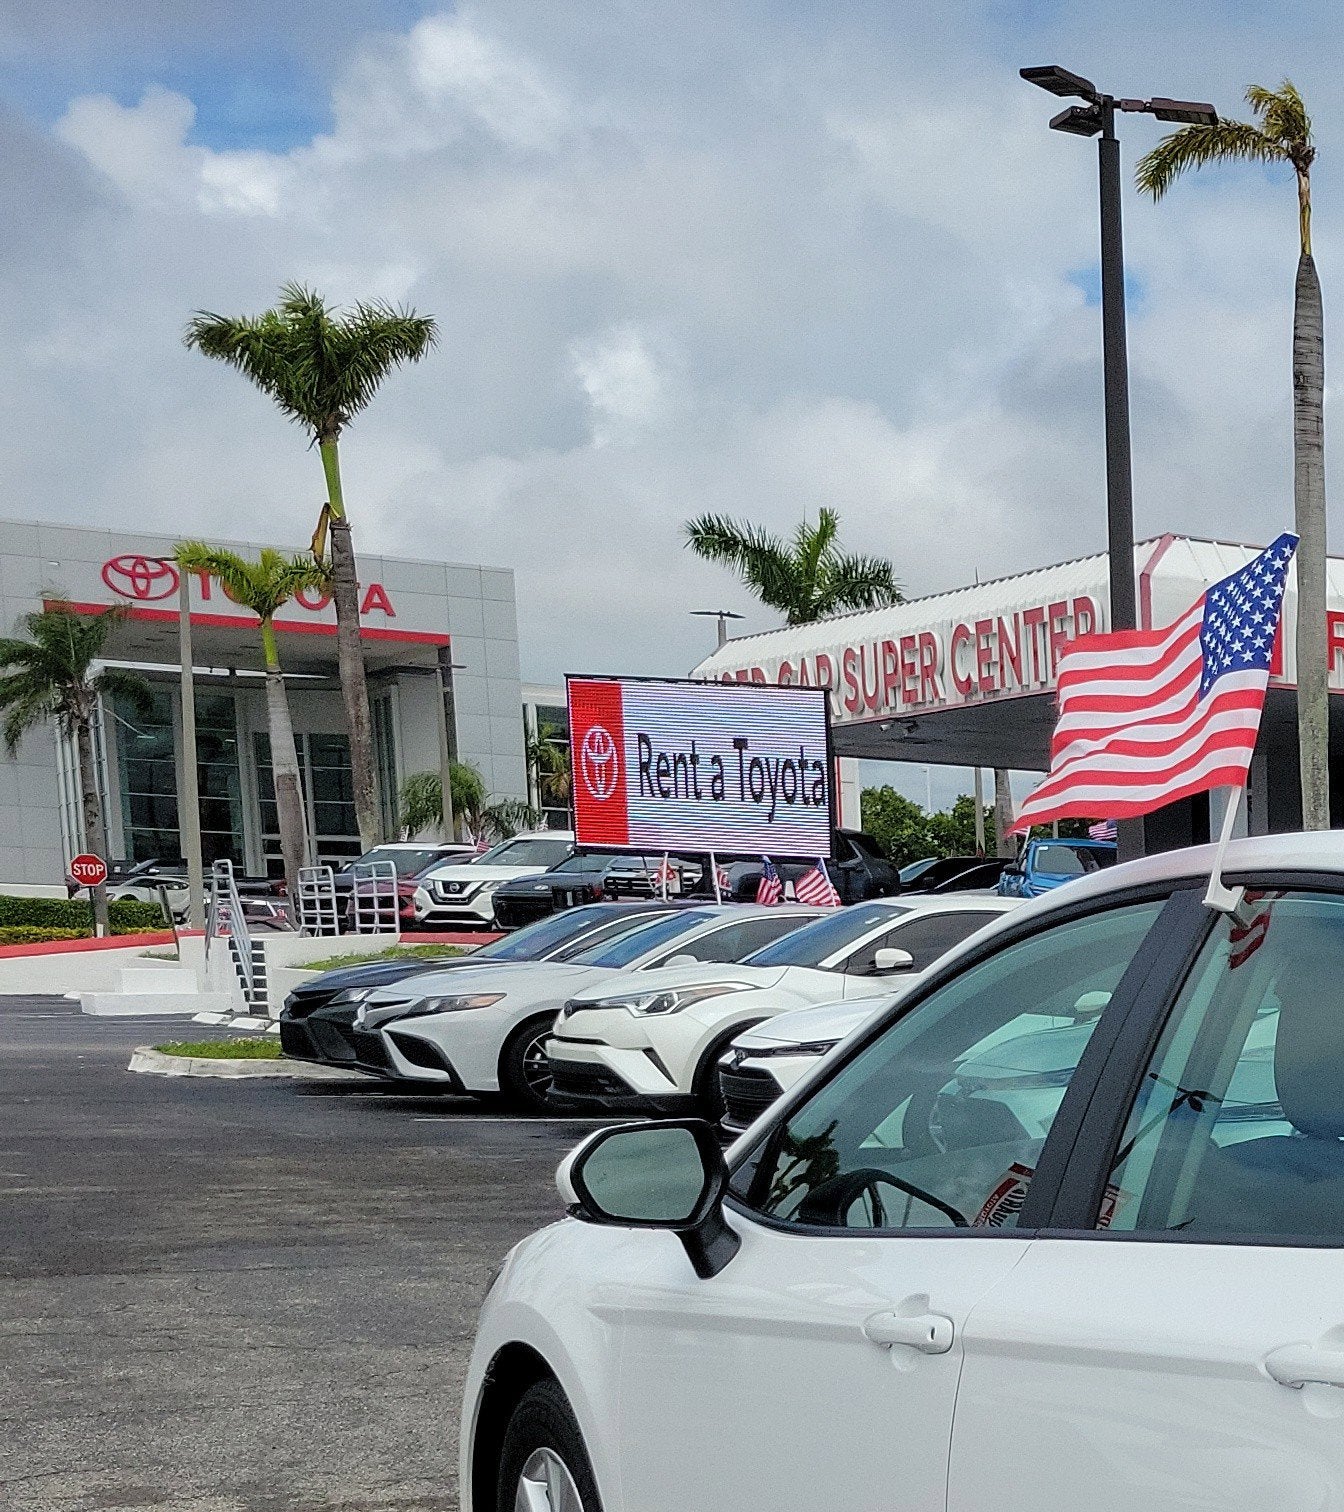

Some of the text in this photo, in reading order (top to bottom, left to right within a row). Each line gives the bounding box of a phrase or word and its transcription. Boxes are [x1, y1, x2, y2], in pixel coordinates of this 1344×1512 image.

[843, 631, 941, 713] SUPER
[637, 733, 826, 823] Rent a Toyota
[73, 863, 104, 876] STOP
